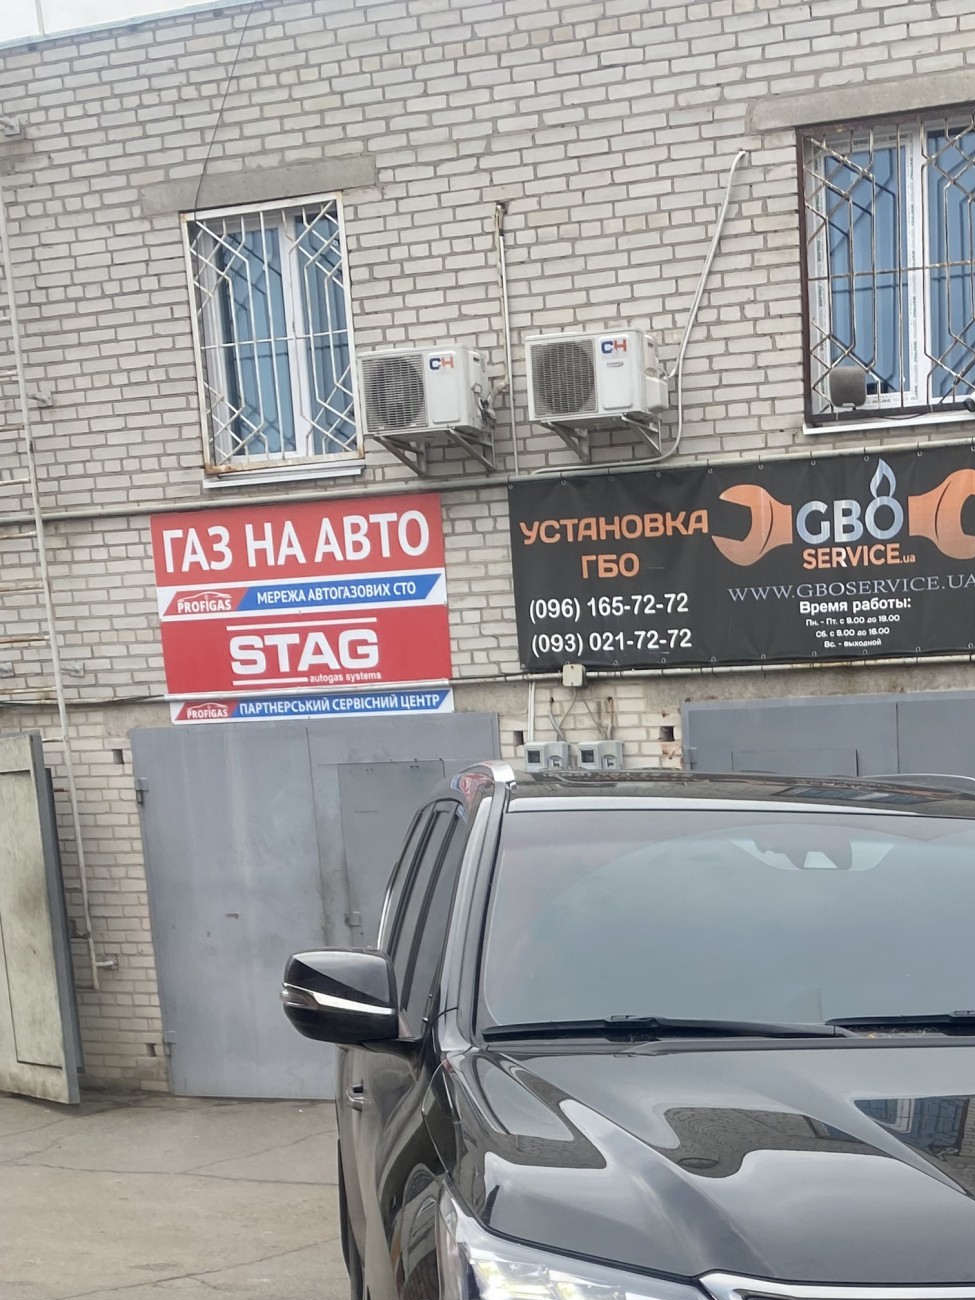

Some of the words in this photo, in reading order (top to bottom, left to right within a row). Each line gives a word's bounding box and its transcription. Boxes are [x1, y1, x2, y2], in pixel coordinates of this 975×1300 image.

[600, 339, 627, 353] CH
[429, 356, 454, 370] CH
[519, 509, 709, 545] УСТАНОВКА
[796, 496, 904, 544] GBO
[162, 526, 233, 573] ГАЗ
[244, 520, 306, 567] НА
[314, 510, 430, 563] АВТО
[581, 552, 640, 579] ГБО
[177, 597, 232, 613] PROFIGAS
[257, 589, 306, 605] МЕРЕЖА
[308, 583, 390, 601] АВТОГАЗОВИХ
[393, 581, 416, 596] СТО
[529, 597, 580, 624] (096)
[587, 592, 689, 617] 165-72-72
[800, 601, 848, 615] Время
[853, 597, 912, 614] работы:
[229, 629, 379, 675] STAG
[531, 633, 584, 657] (093)
[589, 628, 692, 651] 021-72-72
[310, 673, 343, 685] autogas
[345, 671, 382, 683] systems
[239, 697, 331, 715] ПАРТНЕРСЬКИЙ
[332, 693, 398, 711] СЕРВІСНИЙ
[400, 694, 440, 711] ЦЕНТР
